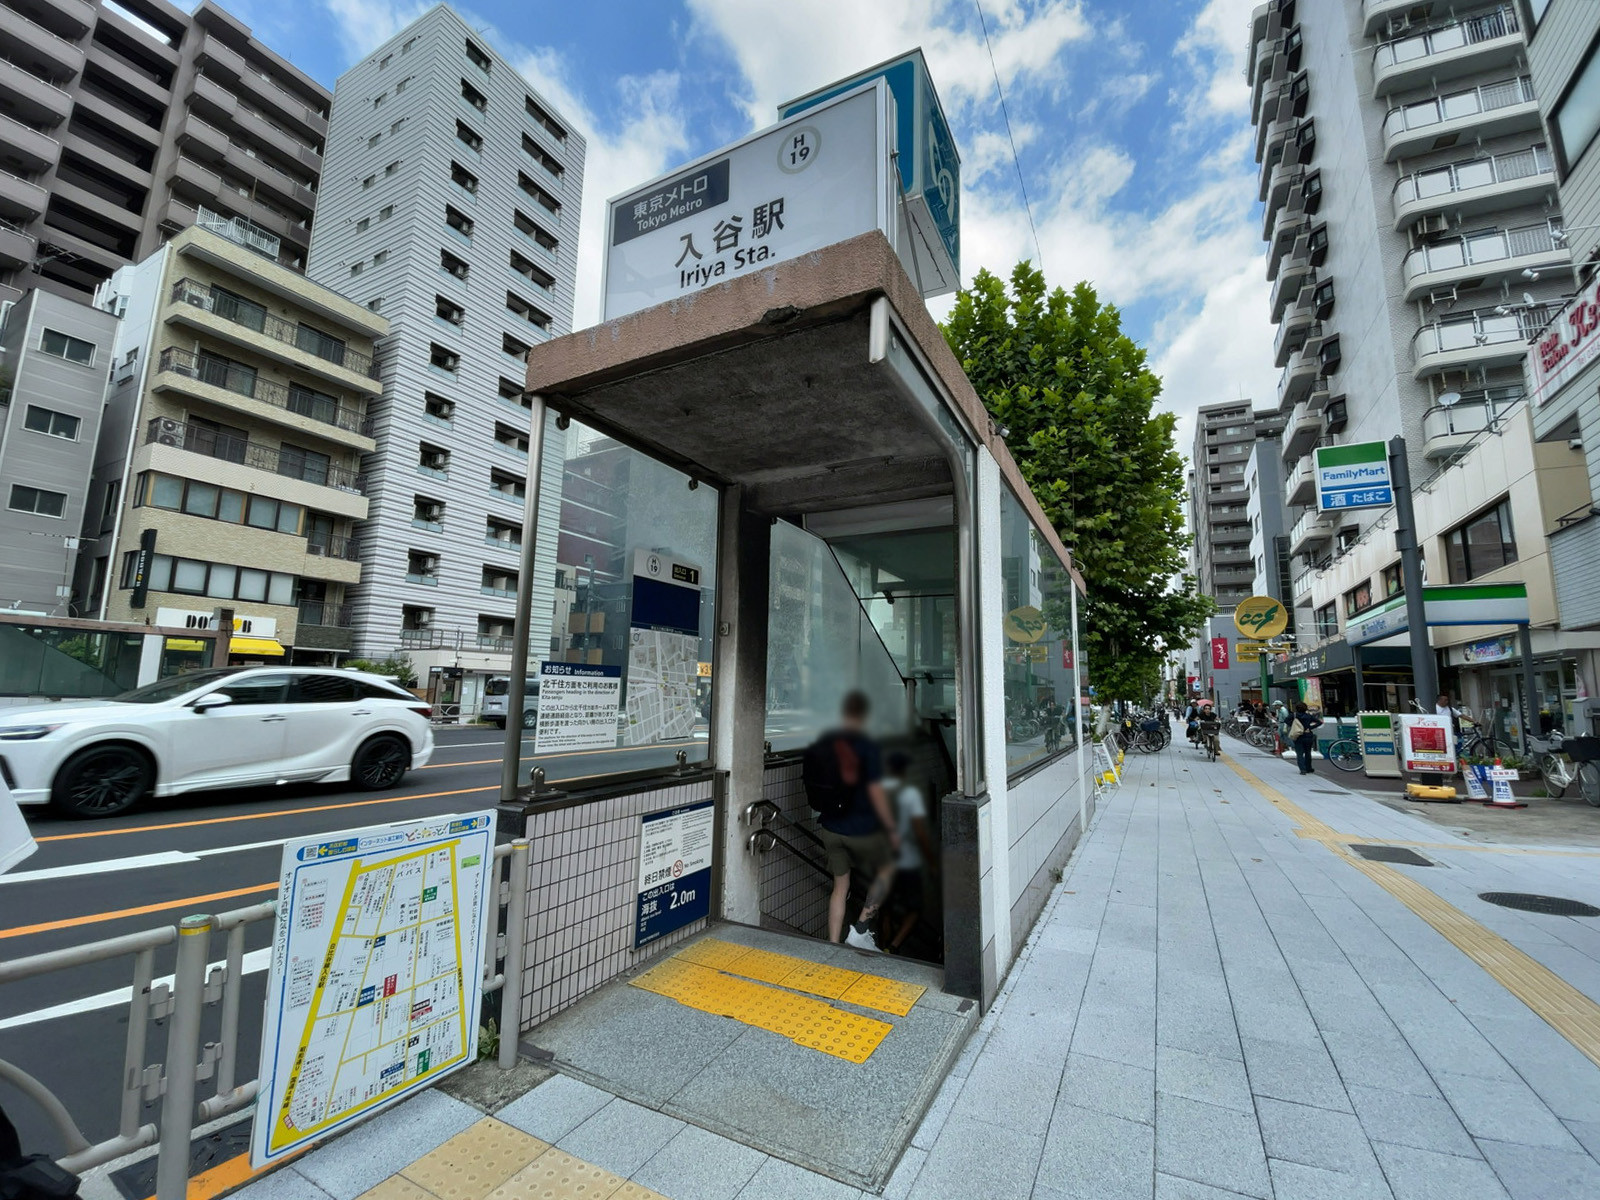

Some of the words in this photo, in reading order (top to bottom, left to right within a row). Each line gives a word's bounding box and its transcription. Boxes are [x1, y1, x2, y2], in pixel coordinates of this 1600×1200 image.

[793, 134, 805, 149] H
[790, 147, 809, 165] 19
[633, 175, 708, 221] 東京メトロ
[637, 210, 668, 232] Tokyo
[670, 198, 703, 218] Metro
[674, 197, 785, 268] 入谷駅
[679, 259, 726, 290] Iriya
[734, 245, 776, 270] Sta.
[1323, 466, 1386, 481] FamilyMart
[1330, 493, 1347, 507] 酒
[1352, 491, 1386, 504] たばこ
[690, 570, 694, 583] 1
[544, 665, 572, 675] お知らせ
[543, 679, 618, 690] 北千住方面をご利用のお客様
[644, 866, 672, 886] 終日禁煙
[642, 883, 675, 902] この出入口は
[641, 900, 658, 917] 海抜
[669, 889, 696, 910] 2.0m
